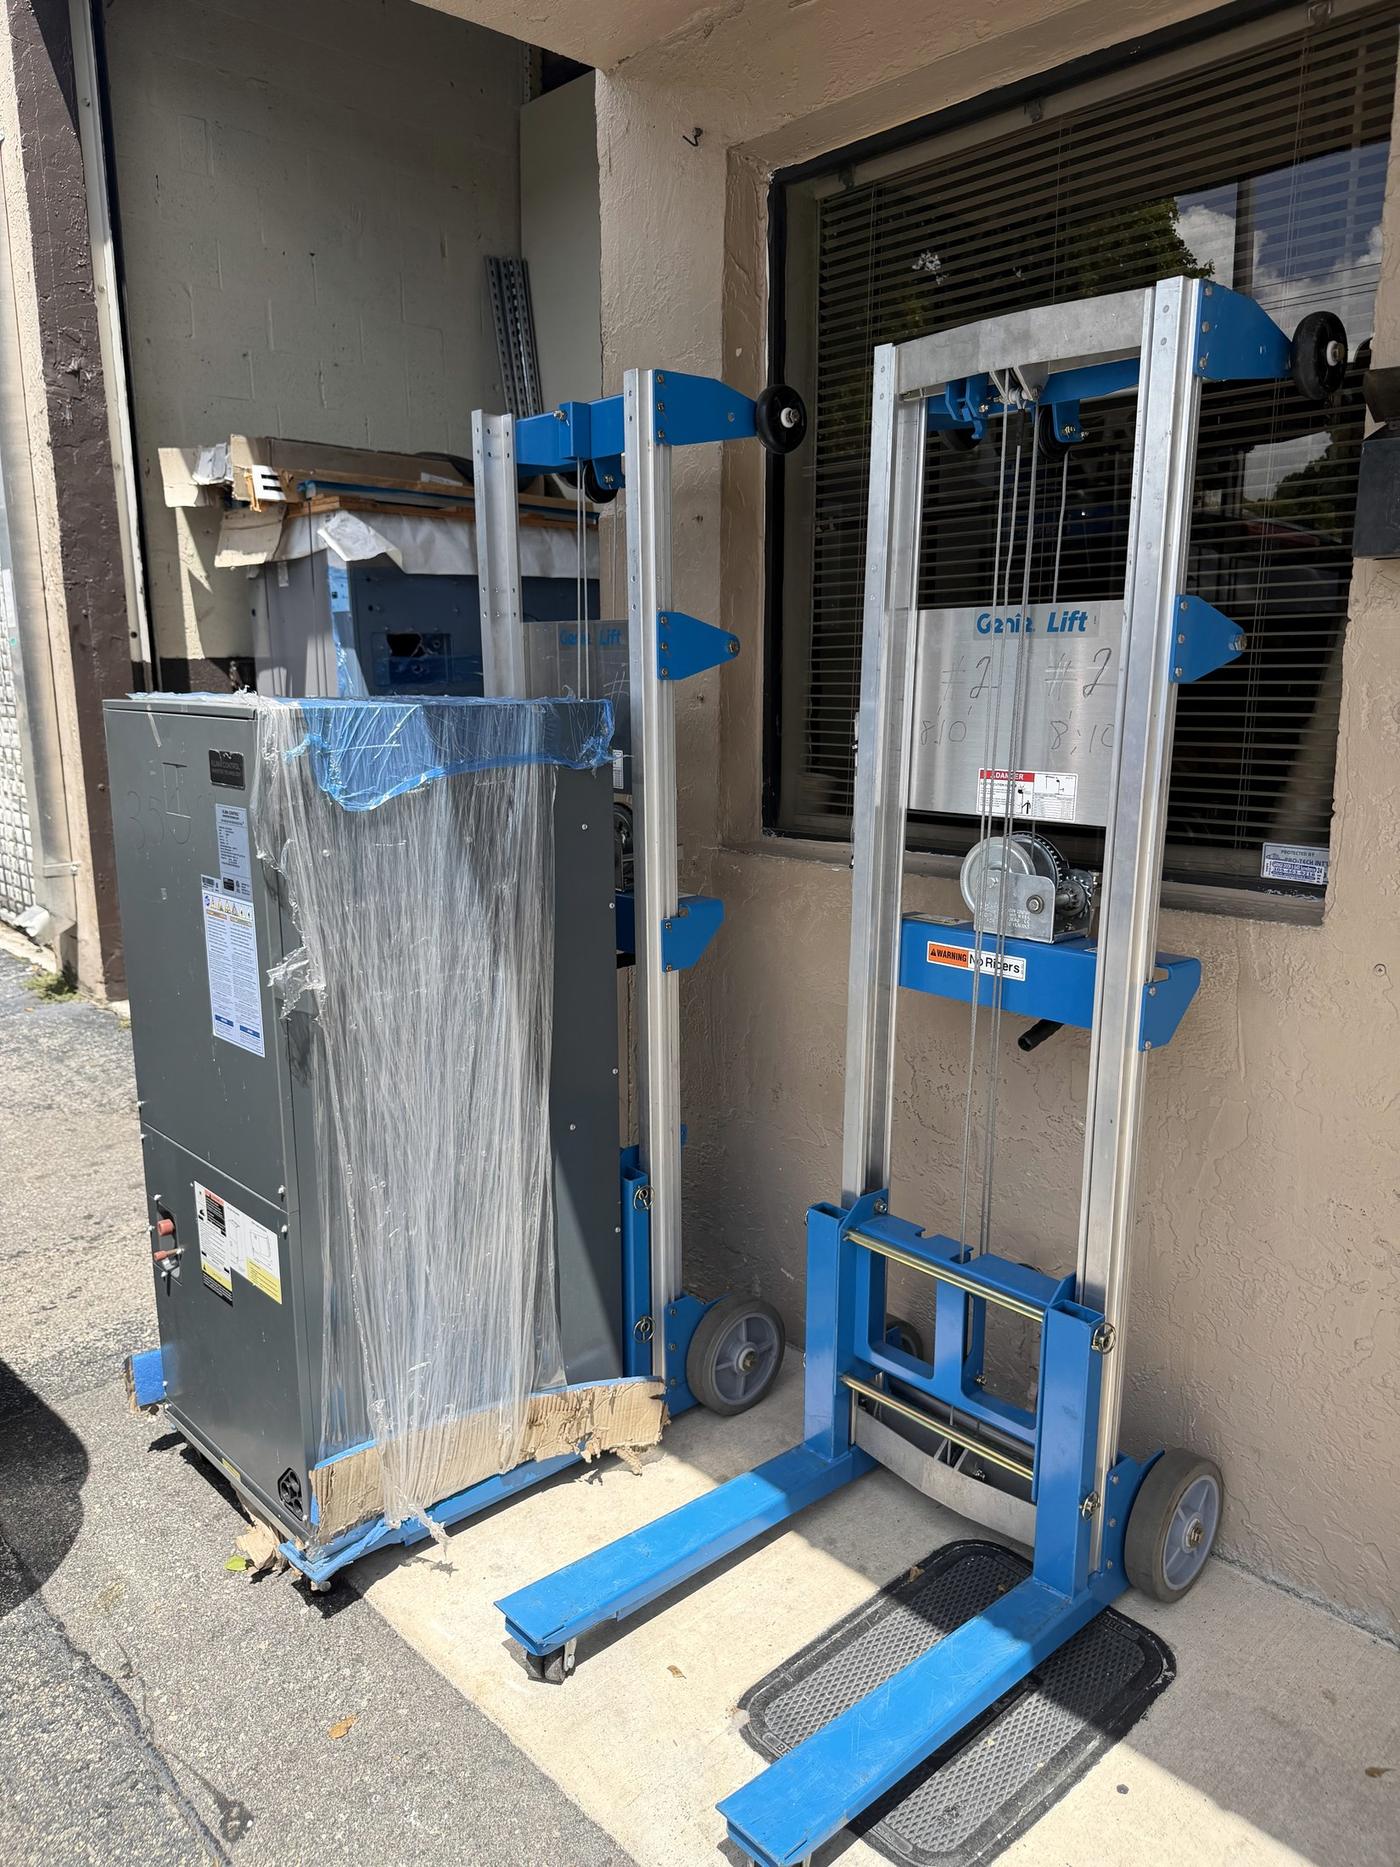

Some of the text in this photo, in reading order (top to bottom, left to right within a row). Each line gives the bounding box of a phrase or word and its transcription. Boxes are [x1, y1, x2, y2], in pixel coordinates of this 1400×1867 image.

[1047, 610, 1088, 633] Lift
[600, 628, 623, 646] Lift
[936, 948, 968, 963] WARNING
